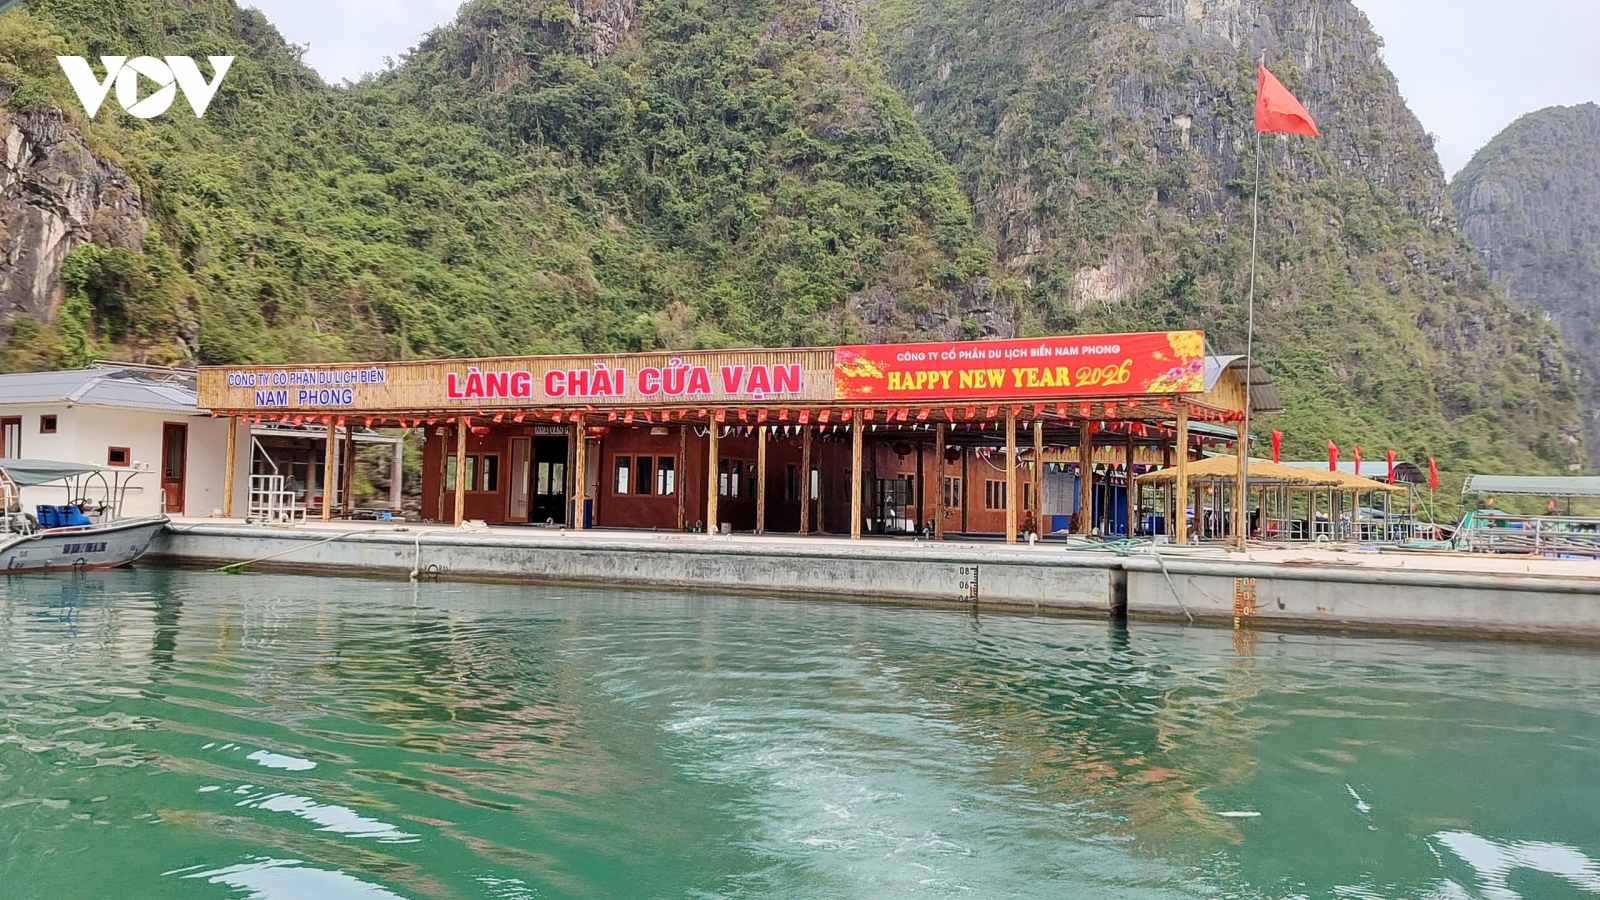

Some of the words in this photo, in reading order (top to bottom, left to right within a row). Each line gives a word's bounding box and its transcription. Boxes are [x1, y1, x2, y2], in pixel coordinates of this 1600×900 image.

[897, 350, 926, 361] CÔNG
[928, 352, 939, 361] TY
[988, 349, 1002, 359] DU
[1004, 348, 1028, 361] LỊCH
[1054, 346, 1079, 356] NAM
[1081, 344, 1121, 355] PHONG
[228, 370, 255, 387] CÔNG
[258, 372, 271, 386] TY
[319, 371, 333, 385] DU
[335, 370, 358, 387] LỊCH
[447, 366, 532, 399] LÀNG
[544, 362, 626, 397] CHÀI
[637, 357, 714, 396] CỬA
[720, 364, 801, 400] VẠN
[887, 369, 954, 391] HAPPY
[959, 368, 1006, 389] NEW
[1011, 366, 1071, 388] YEAR
[1075, 358, 1133, 388] 2026
[255, 390, 288, 407] NAM
[298, 388, 353, 406] PHONG
[960, 567, 969, 575] 08
[959, 581, 969, 589] 06
[1243, 577, 1256, 587] 08
